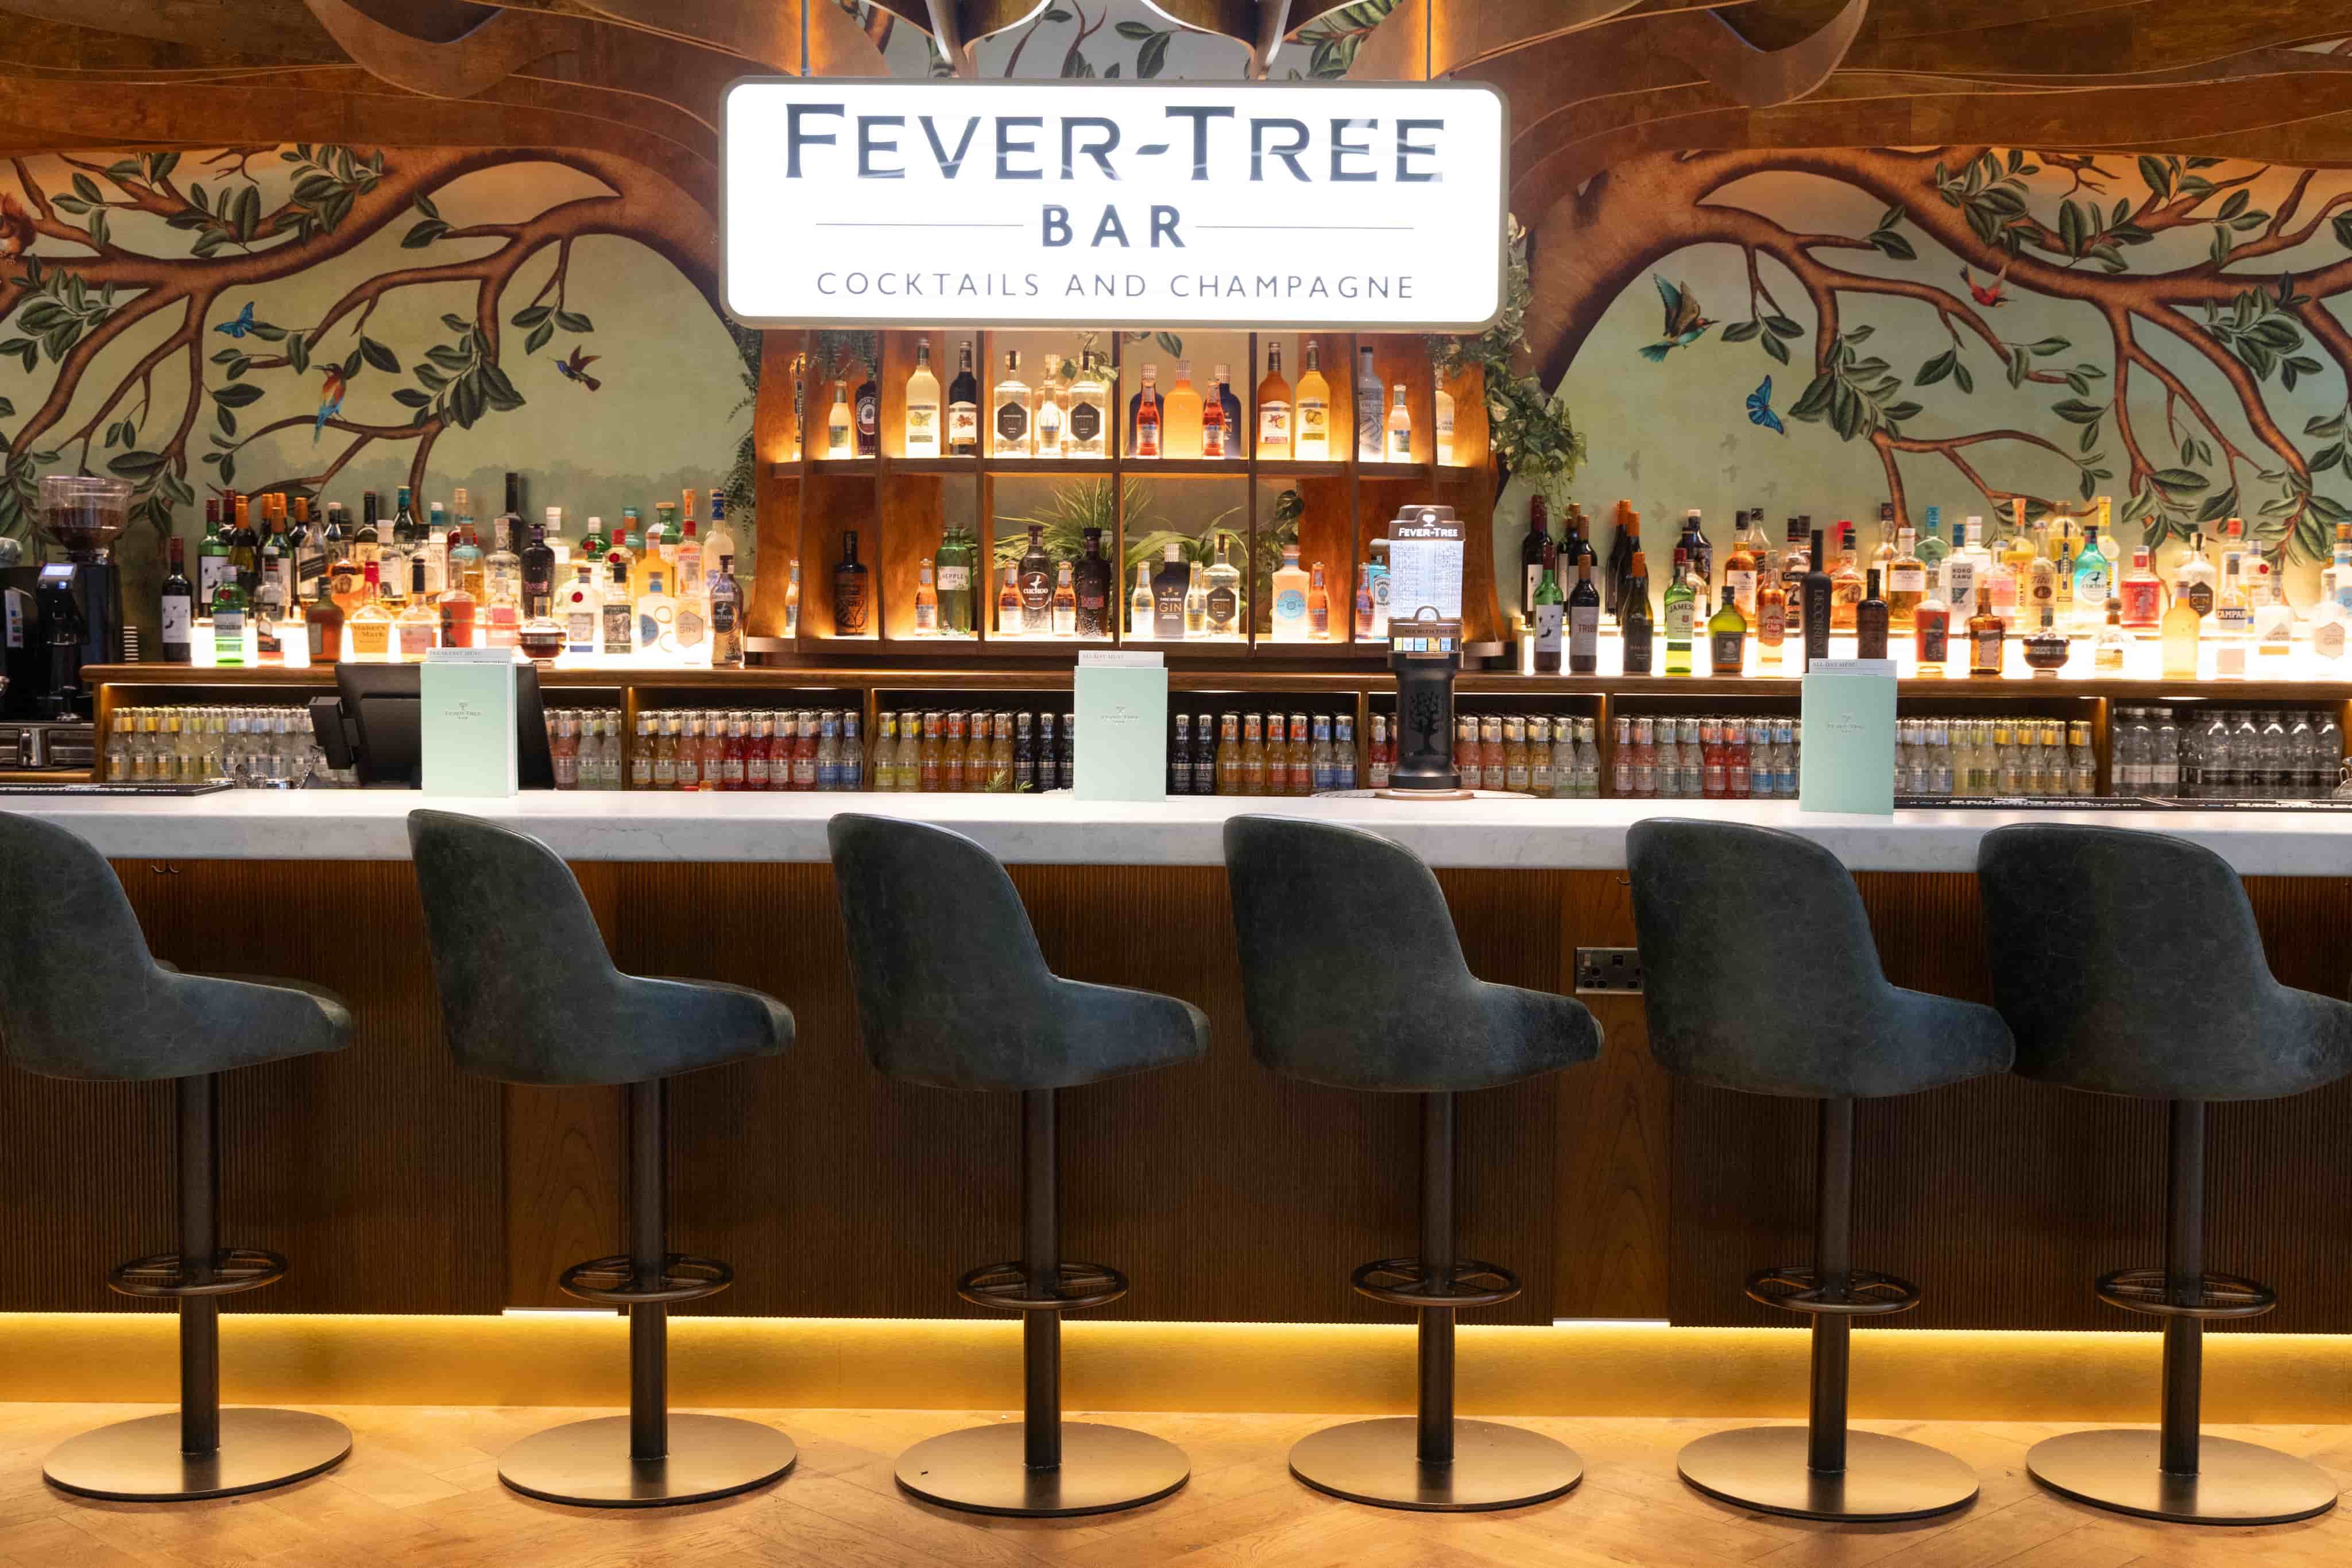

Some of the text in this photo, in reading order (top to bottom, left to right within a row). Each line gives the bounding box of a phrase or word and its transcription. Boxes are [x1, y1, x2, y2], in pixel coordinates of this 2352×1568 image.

[786, 103, 1445, 183] FEVER-TREE
[1042, 204, 1186, 248] BAR
[817, 272, 1413, 299] COCKTAILS AND CHAMPAGNE
[1398, 527, 1459, 537] FEVER-TREE
[1159, 602, 1182, 613] GIN
[679, 625, 697, 634] GIN
